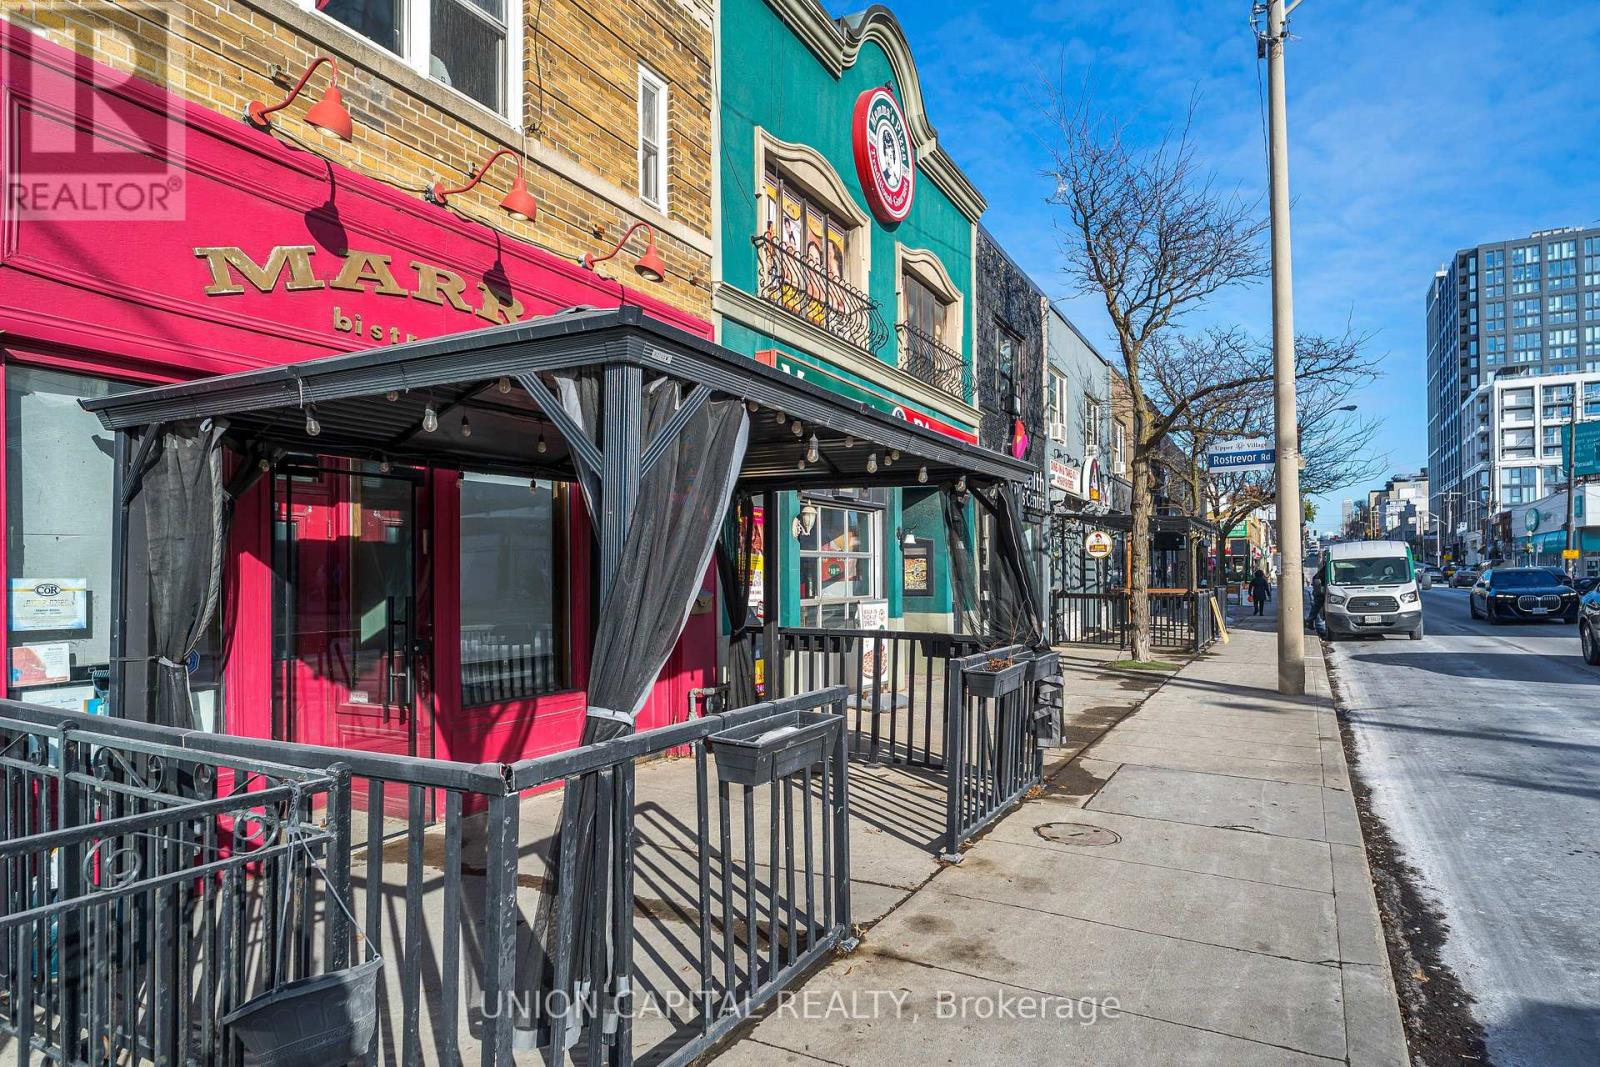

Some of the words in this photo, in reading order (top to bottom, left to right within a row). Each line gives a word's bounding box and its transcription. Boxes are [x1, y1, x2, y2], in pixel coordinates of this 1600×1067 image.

[193, 244, 545, 326] MARR
[332, 306, 418, 344] bistr
[1213, 454, 1257, 465] Rostrevor
[1260, 452, 1271, 461] Rd
